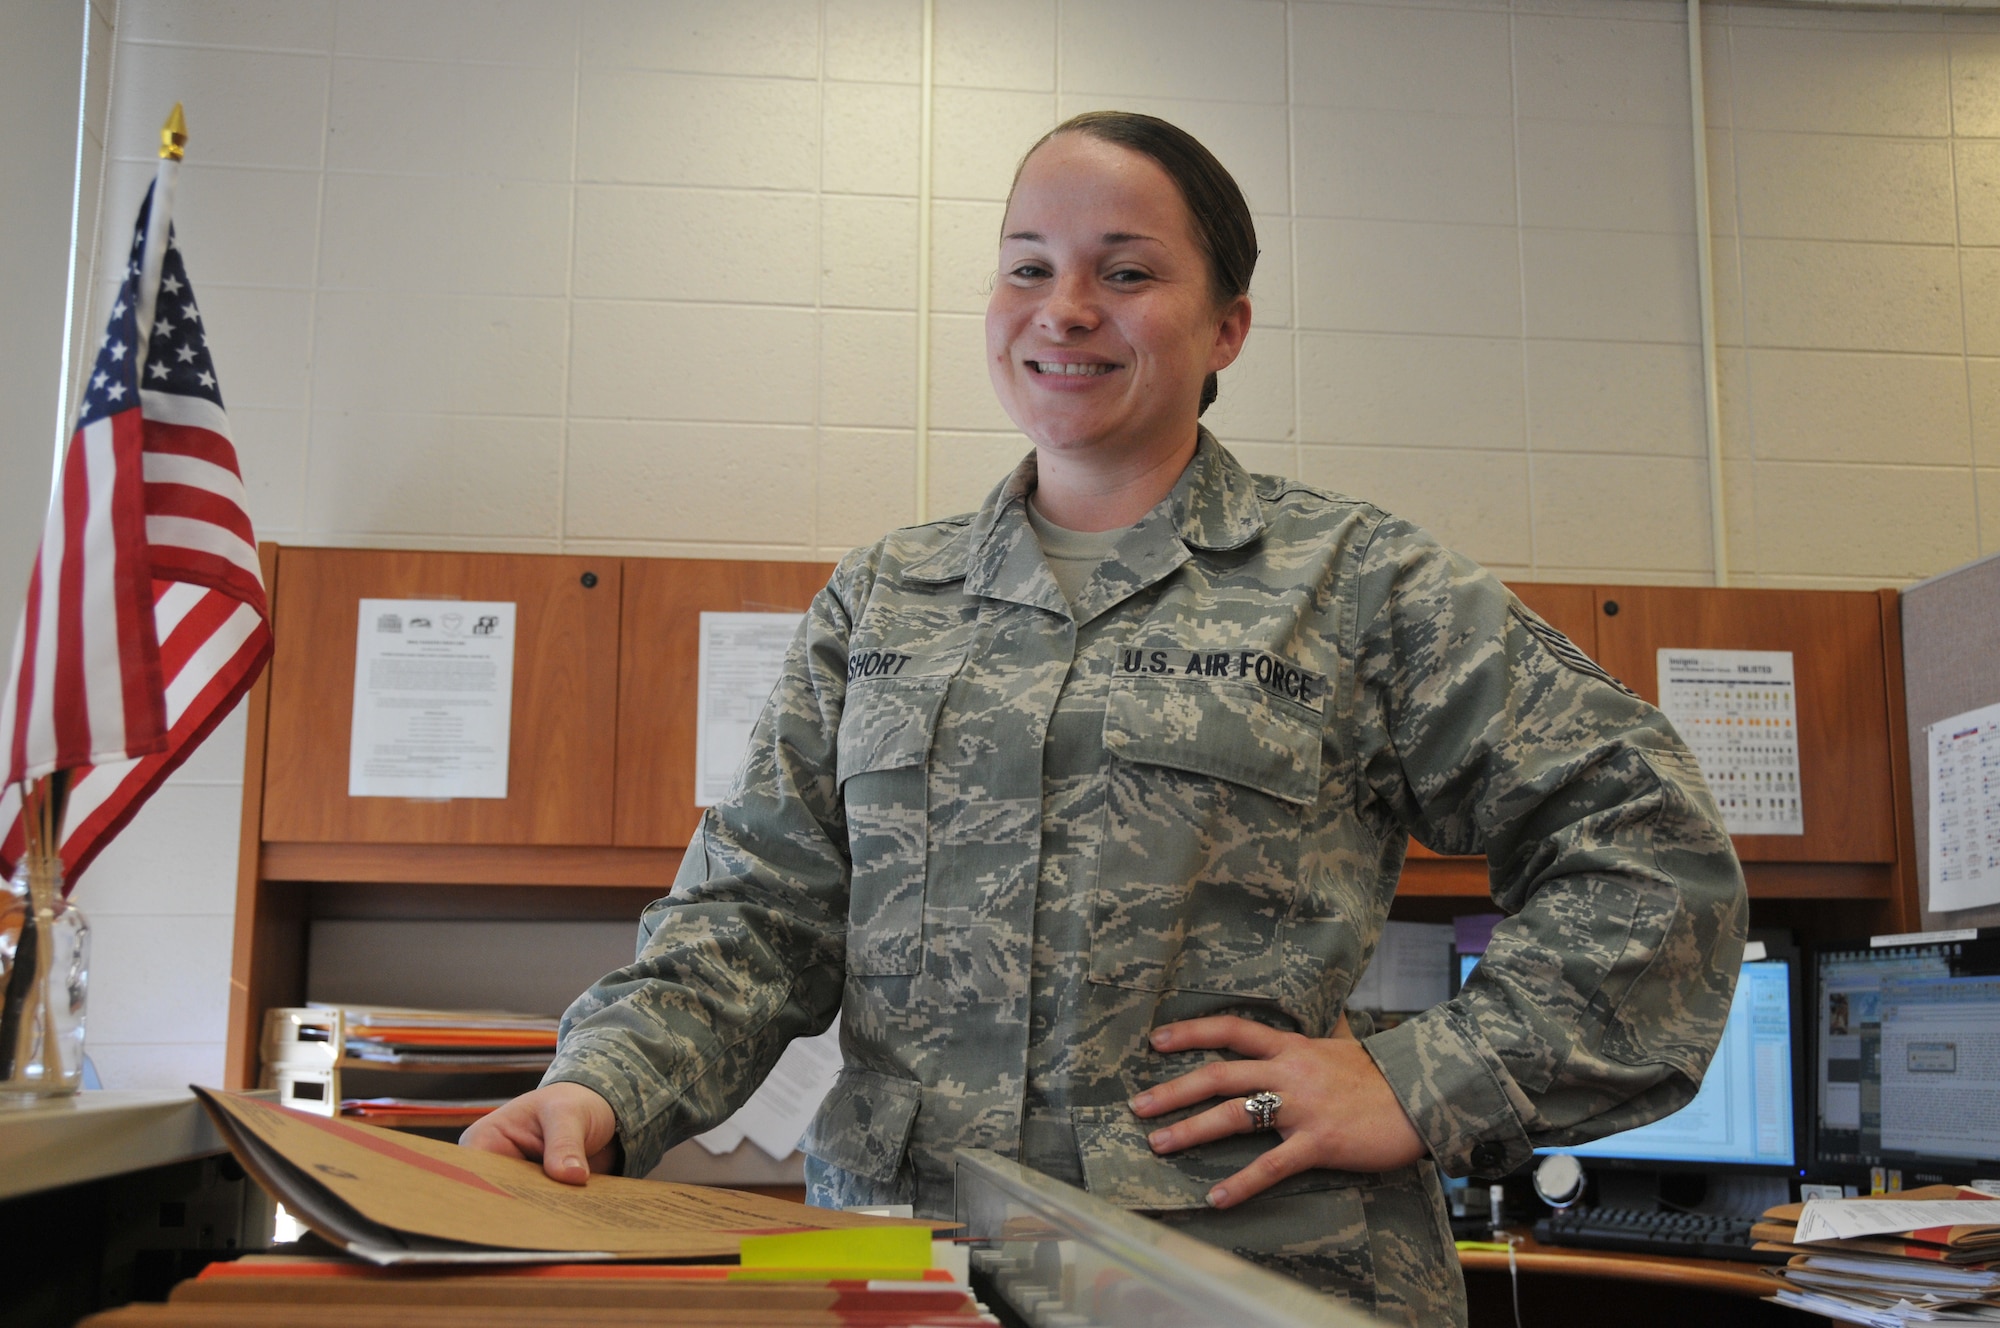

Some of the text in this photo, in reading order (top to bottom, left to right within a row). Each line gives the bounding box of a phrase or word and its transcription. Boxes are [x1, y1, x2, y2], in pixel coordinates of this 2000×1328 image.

[848, 652, 912, 683] SHORT
[1124, 649, 1314, 703] U.S. AIR FORCE
